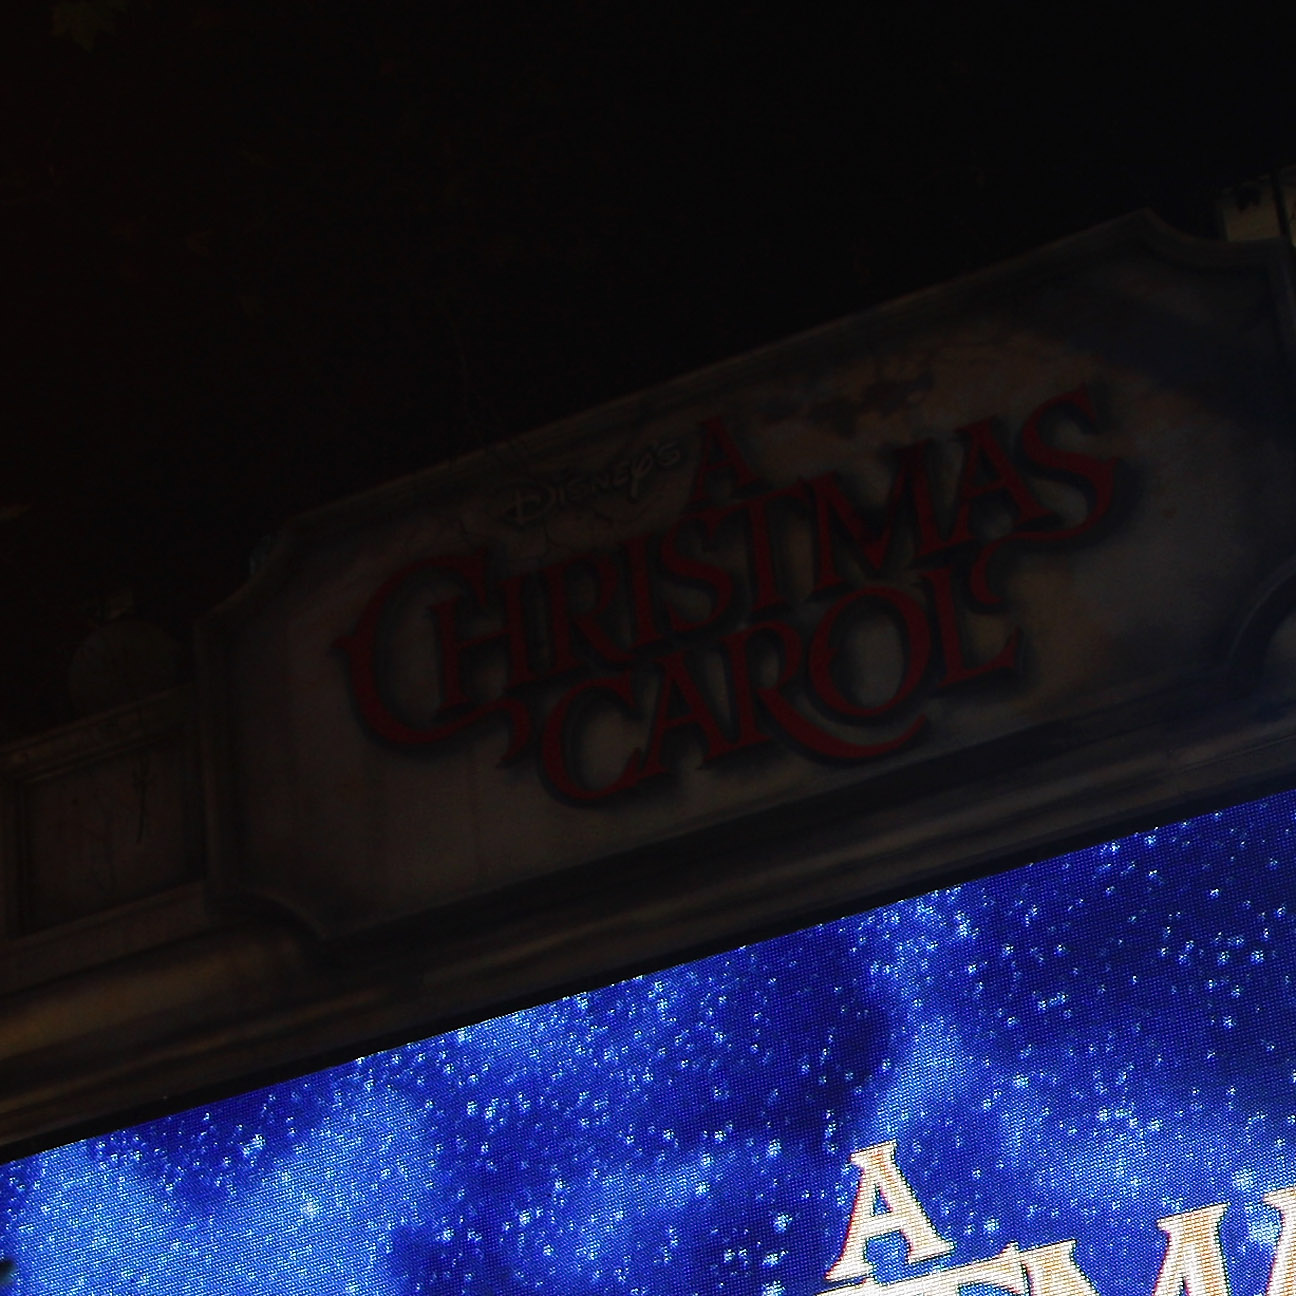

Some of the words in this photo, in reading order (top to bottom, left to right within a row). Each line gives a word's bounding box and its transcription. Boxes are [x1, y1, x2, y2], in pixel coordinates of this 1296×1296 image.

[692, 416, 766, 502] A
[332, 385, 1120, 767] CHRISTMAS
[541, 566, 1025, 800] CAROL
[828, 1141, 953, 1284] A
